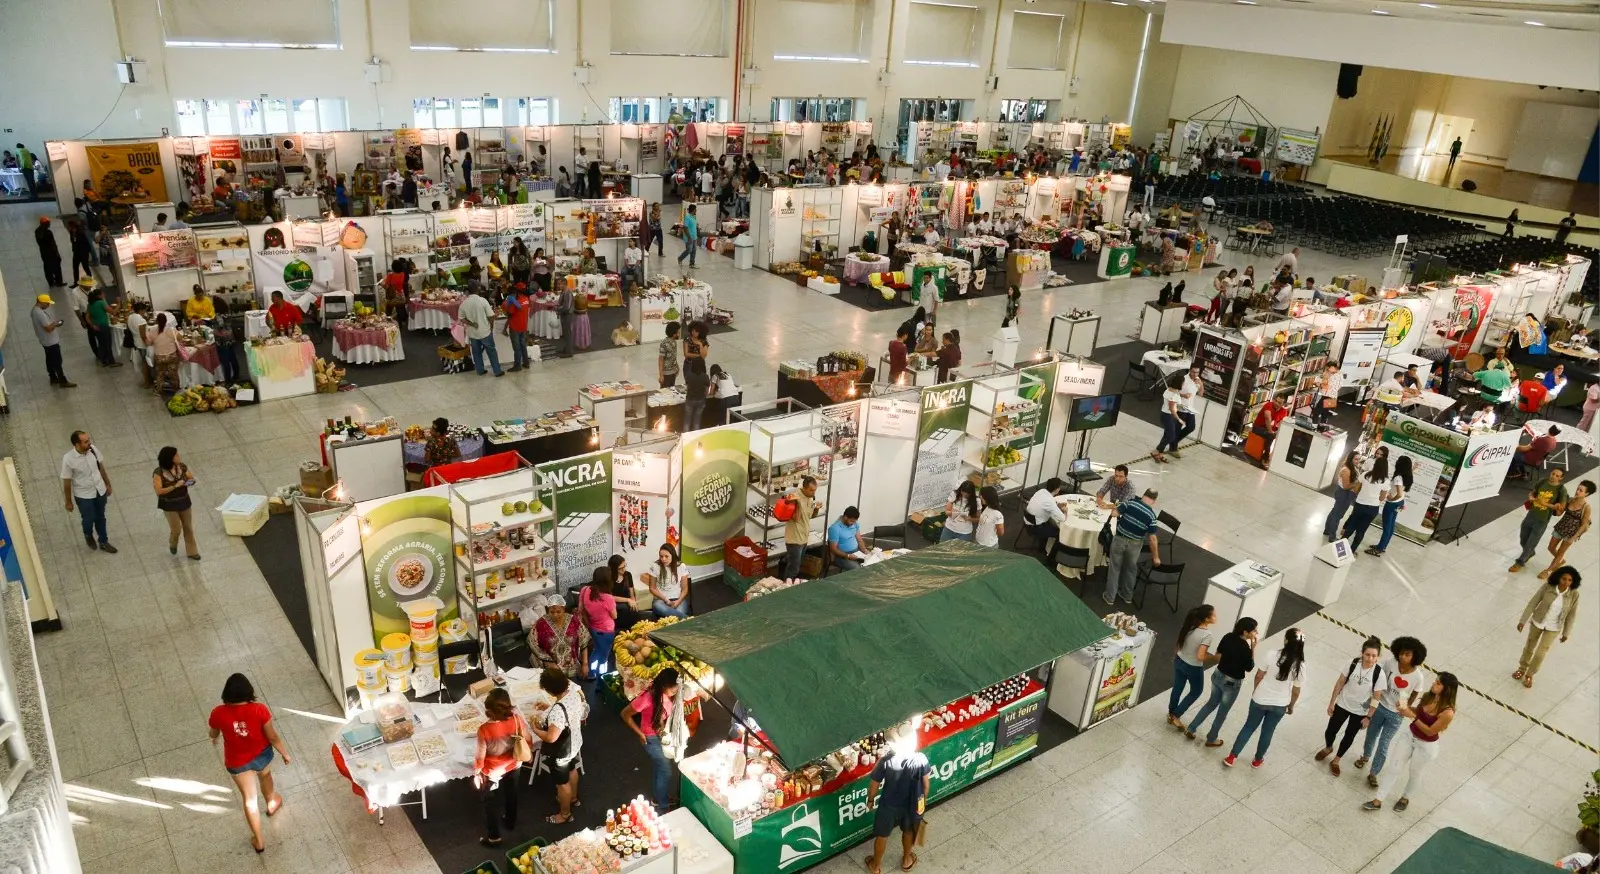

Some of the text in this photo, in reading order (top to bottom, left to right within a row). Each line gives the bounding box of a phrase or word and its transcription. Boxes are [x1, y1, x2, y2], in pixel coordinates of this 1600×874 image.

[126, 152, 160, 168] BARU
[158, 232, 188, 242] Prendas
[1064, 376, 1096, 385] SEAD/INCRA
[924, 386, 966, 409] INCRA
[1482, 445, 1511, 460] CIPPAL
[541, 460, 607, 490] INCRA
[701, 472, 720, 486] TEM
[693, 476, 732, 500] REFORMA
[376, 544, 404, 572] REFORMA
[435, 552, 445, 567] TEM
[373, 574, 381, 589] TEM
[431, 566, 446, 595] COMIDA
[377, 589, 387, 598] SE
[1004, 702, 1038, 724] kit feira
[927, 741, 995, 781] Agrária
[838, 787, 868, 806] Feira
